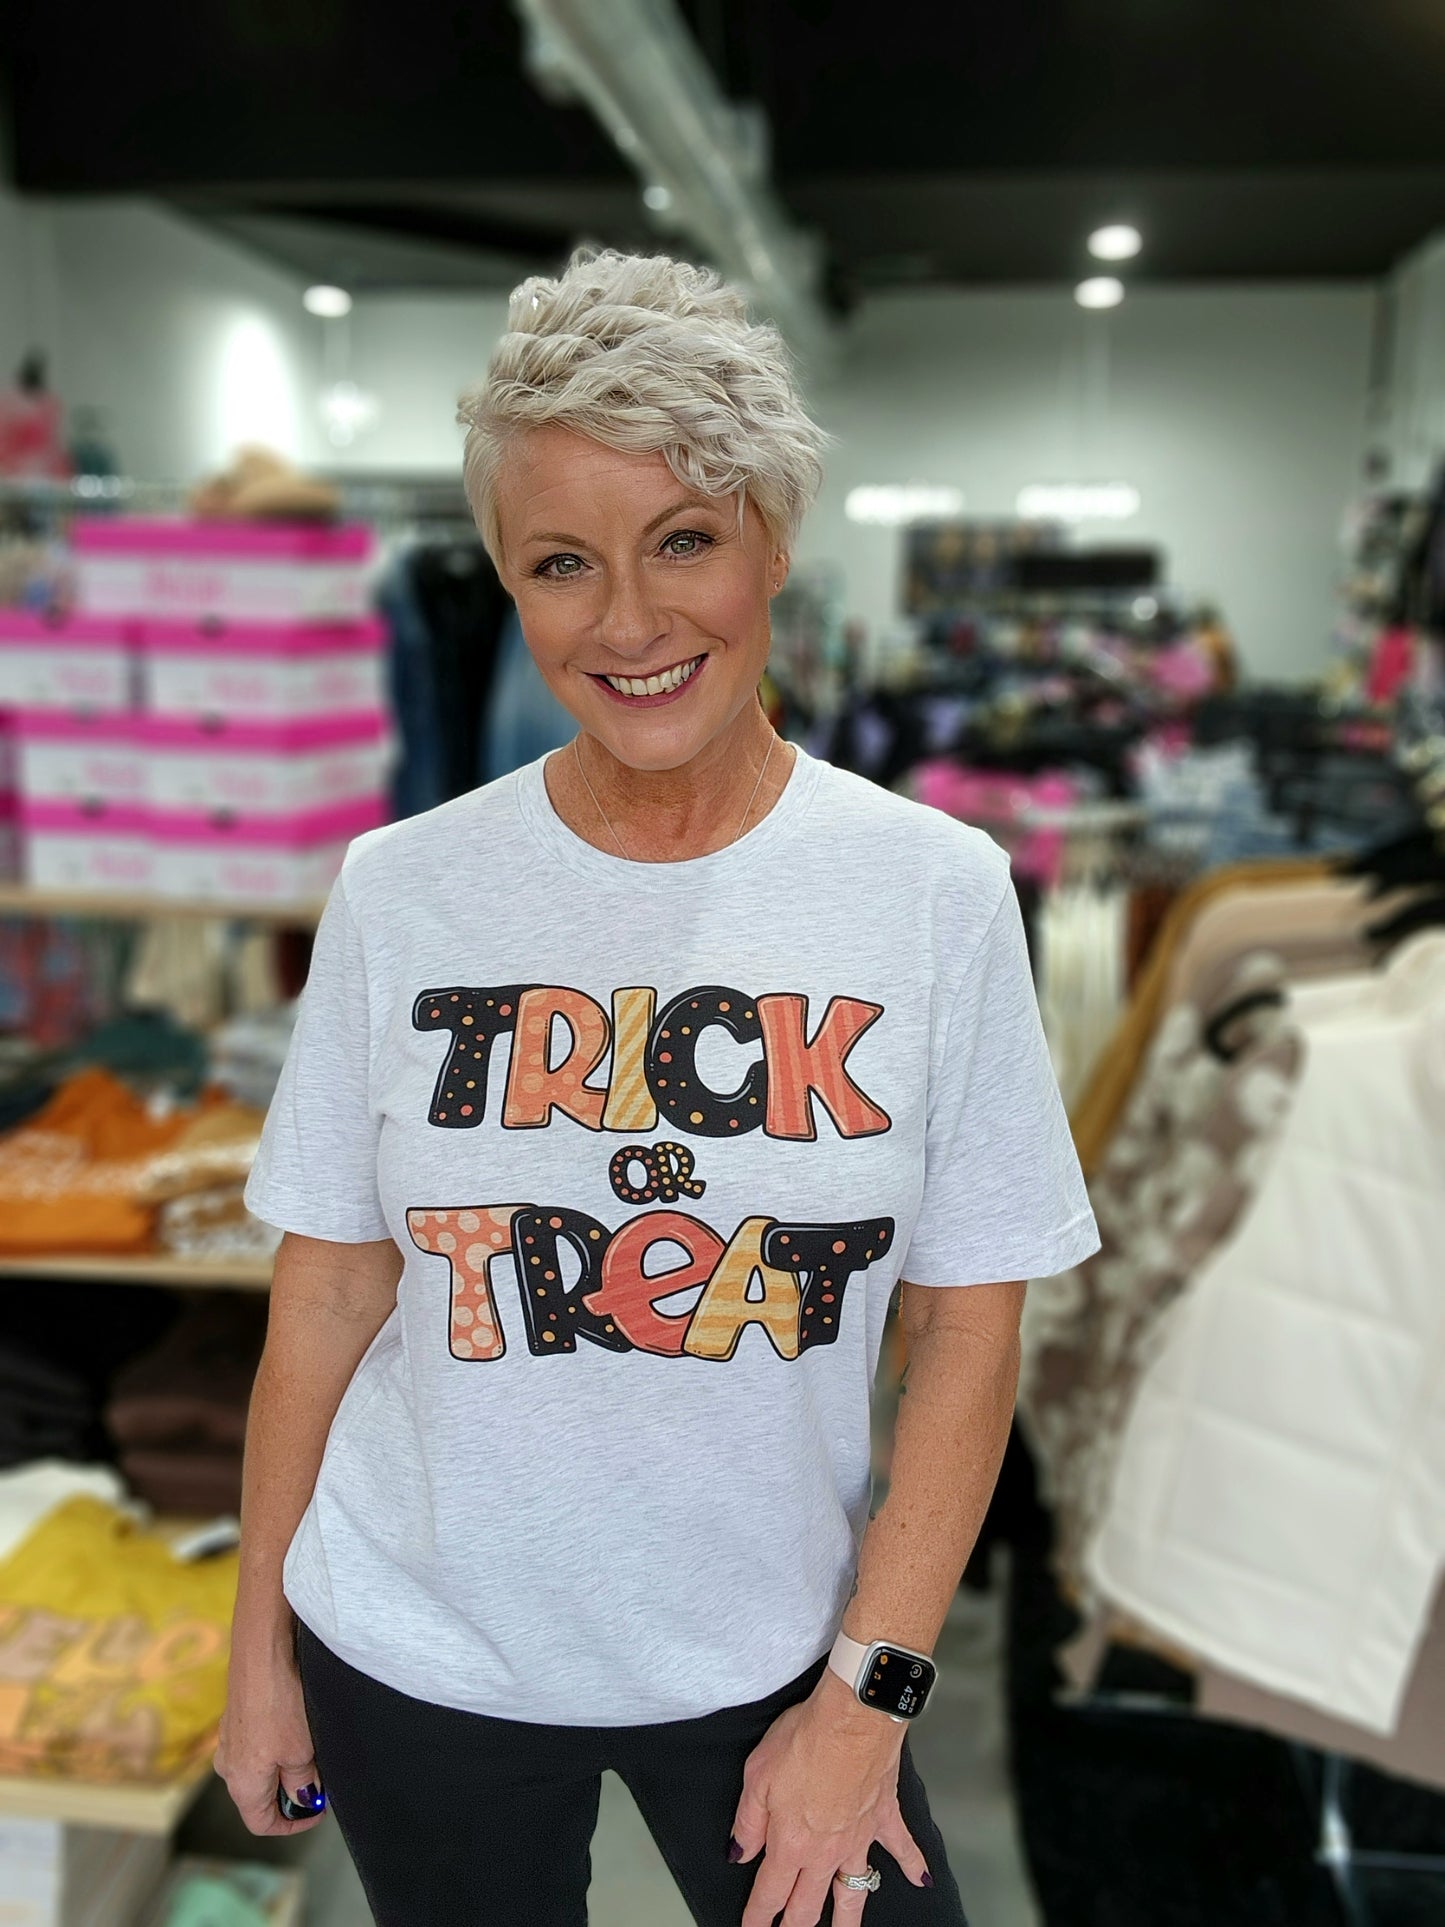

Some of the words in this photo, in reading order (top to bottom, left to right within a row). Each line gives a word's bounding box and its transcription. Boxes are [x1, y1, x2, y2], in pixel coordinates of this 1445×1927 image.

[412, 984, 892, 1142] TRICK
[609, 1141, 706, 1204] OR
[898, 1685, 913, 1711] 4:28
